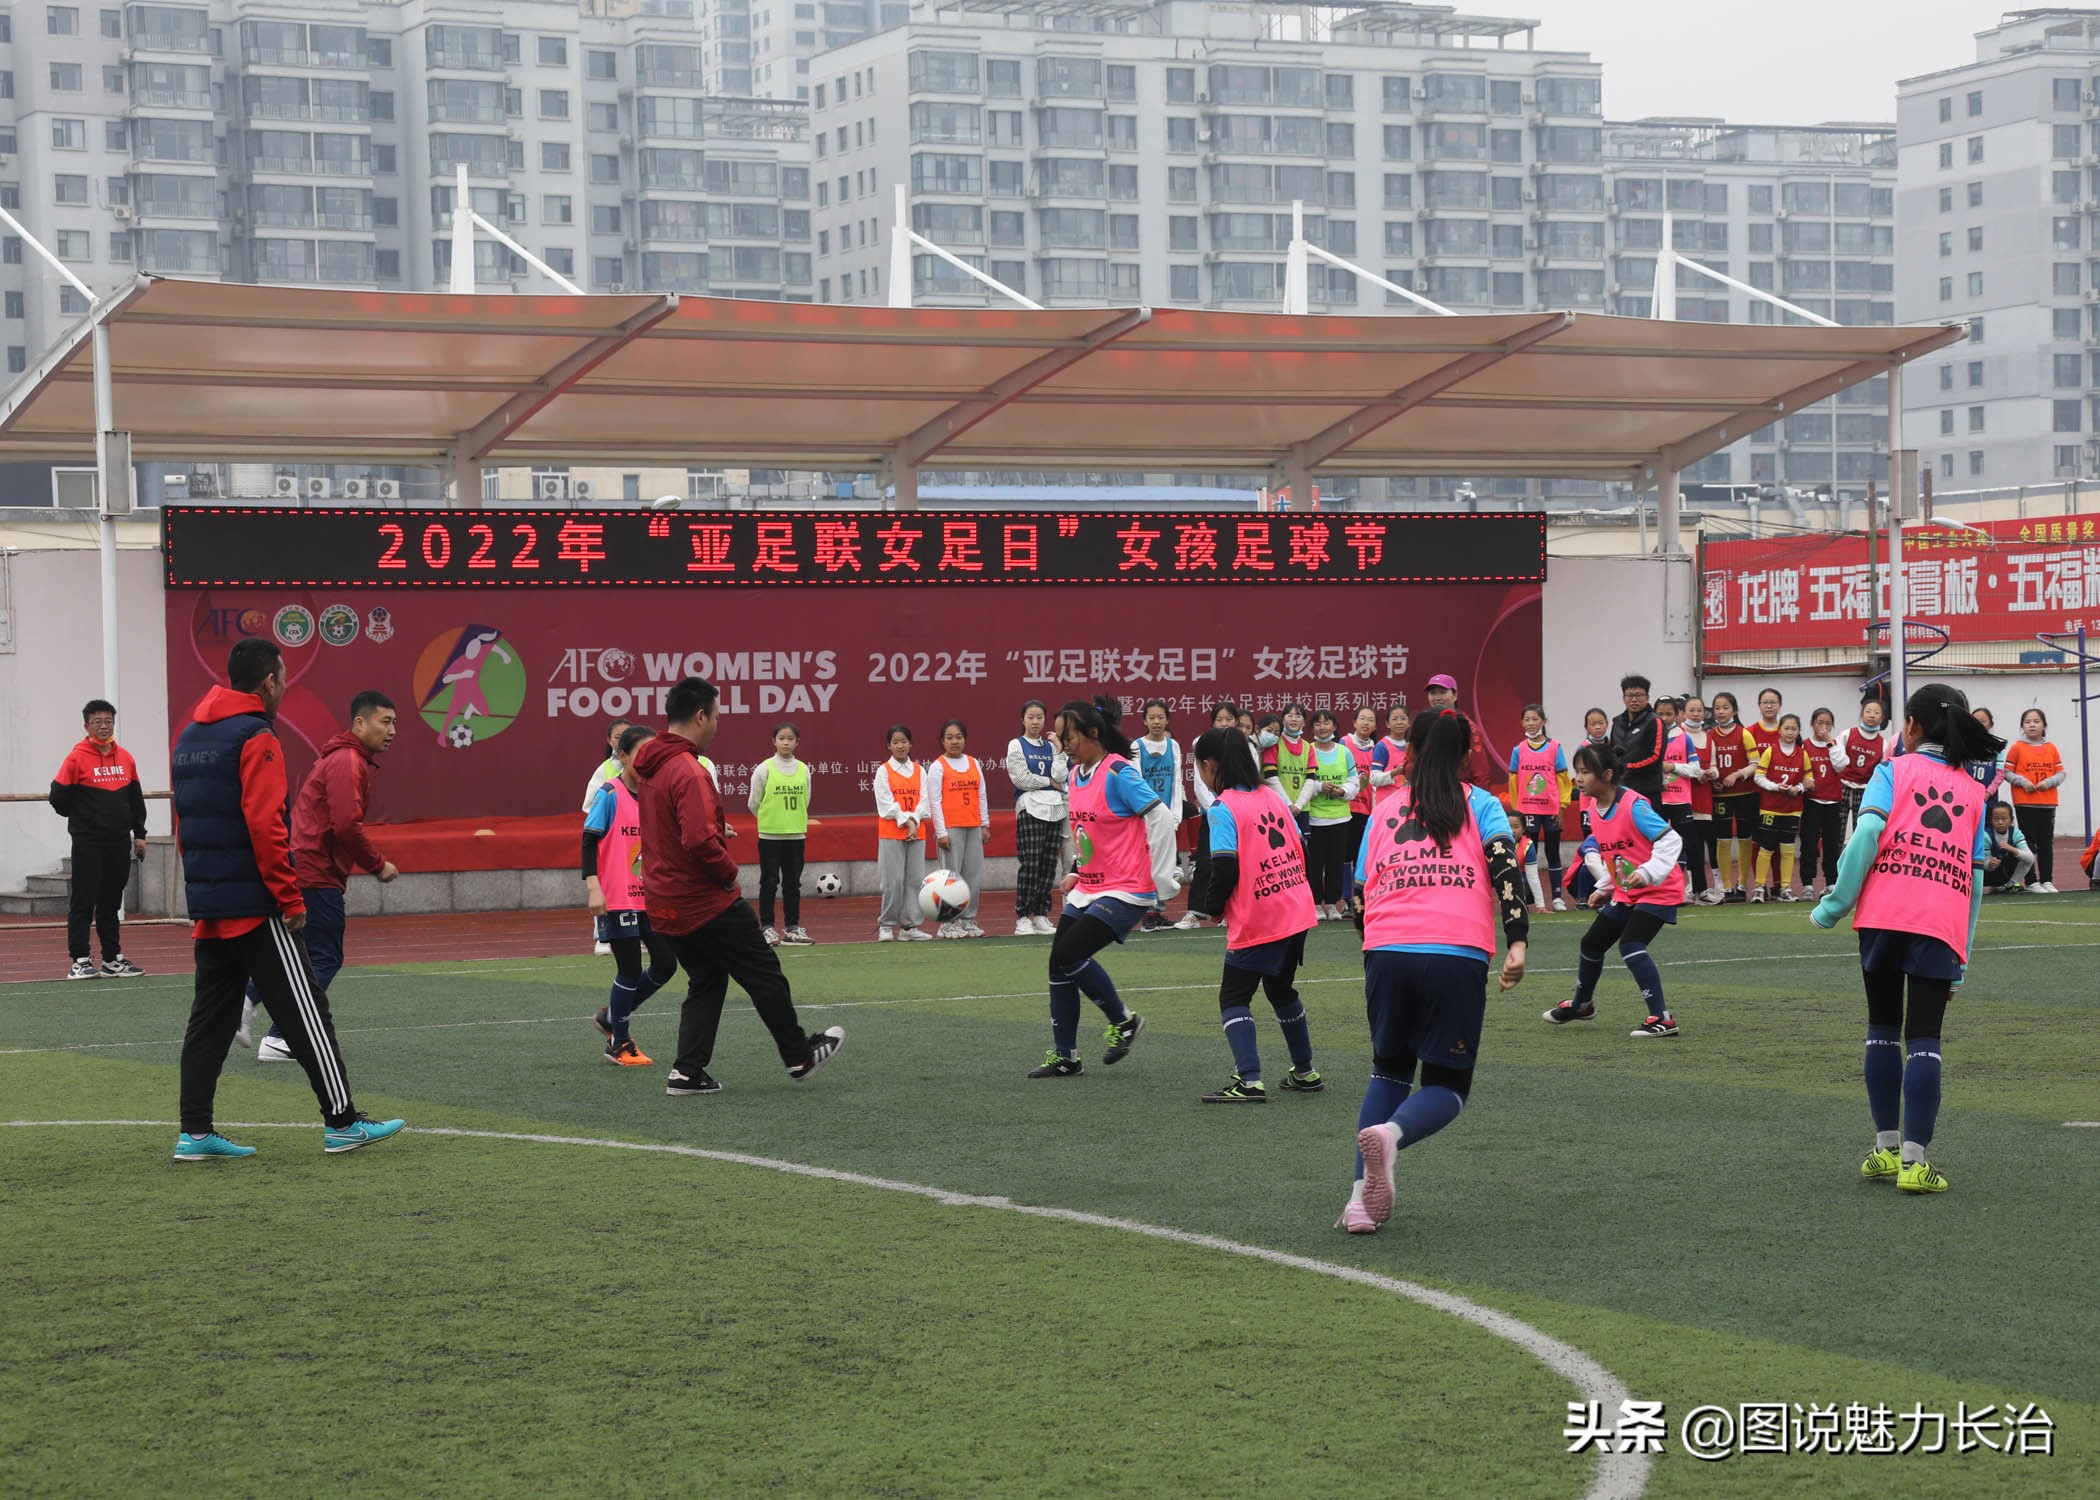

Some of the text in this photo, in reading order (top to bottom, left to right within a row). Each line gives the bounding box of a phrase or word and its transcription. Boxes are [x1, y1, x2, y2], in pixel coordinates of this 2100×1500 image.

[548, 647, 637, 684] AFC
[547, 684, 838, 717] FOOTLL DAY
[1718, 753, 1732, 768] 10
[1856, 754, 1866, 767] 8
[1037, 761, 1045, 775] 9
[1819, 764, 1827, 778] 9
[1972, 765, 1985, 780] 10
[1292, 776, 1300, 790] 9
[783, 796, 797, 810] 10
[962, 792, 970, 805] 5
[1893, 831, 1967, 865] KELME
[1376, 845, 1453, 874] KELME
[1440, 875, 1475, 889] DAY
